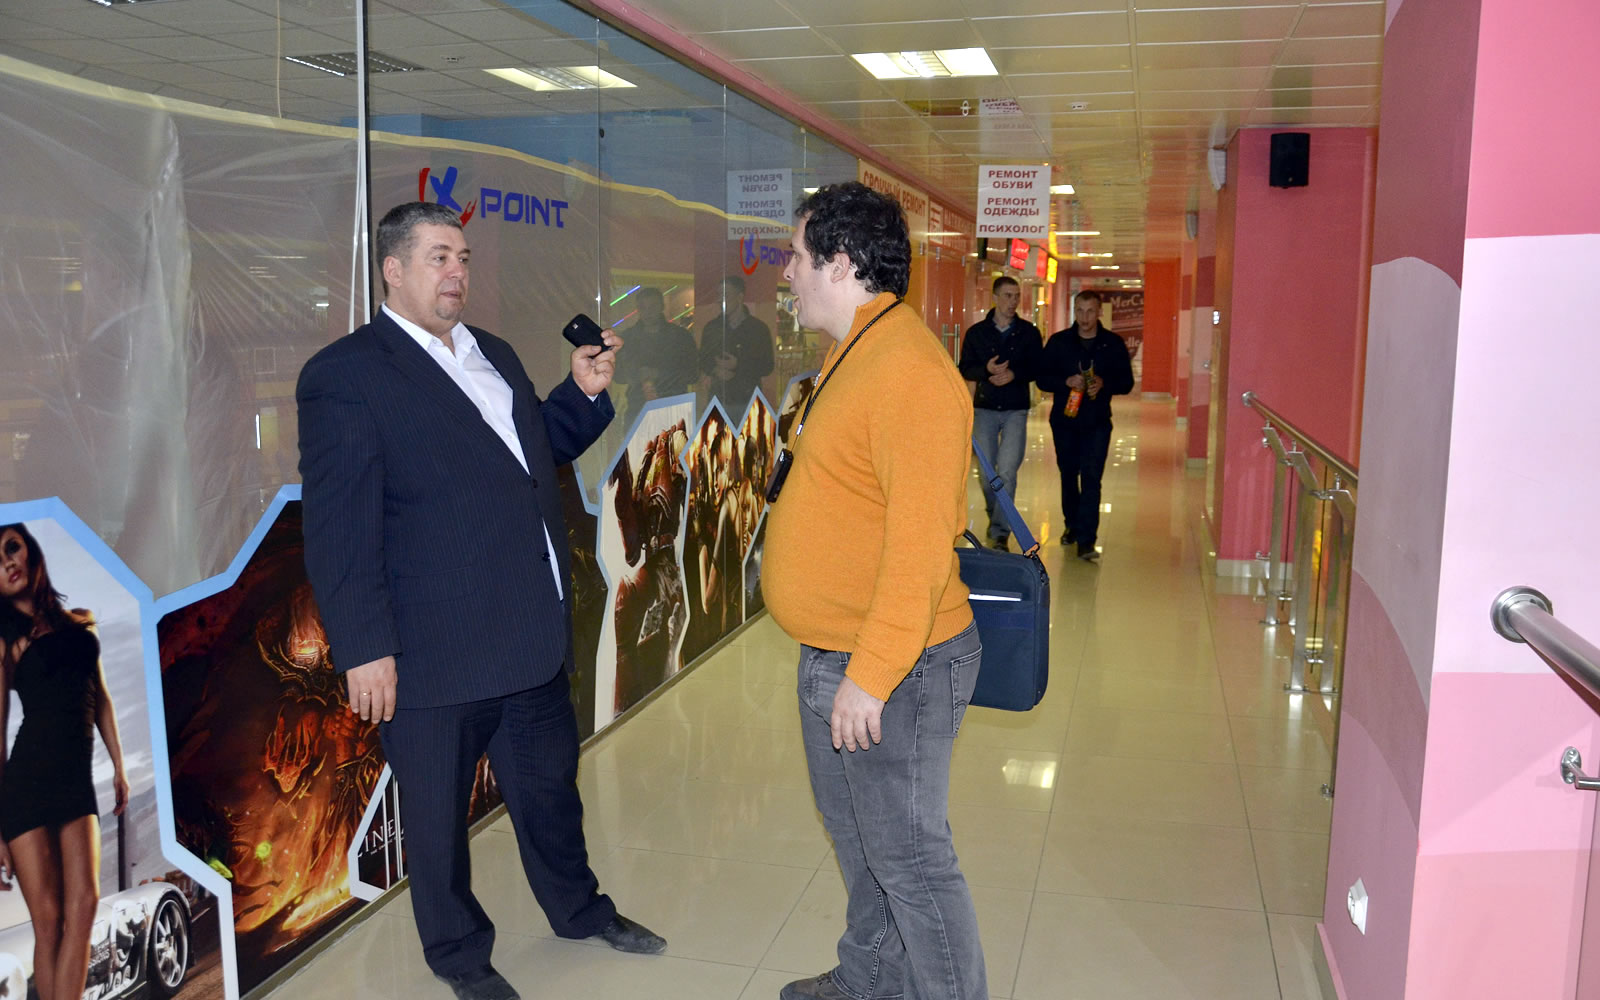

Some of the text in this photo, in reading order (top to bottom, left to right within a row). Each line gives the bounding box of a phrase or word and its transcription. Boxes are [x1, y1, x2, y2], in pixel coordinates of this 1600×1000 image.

[988, 170, 1038, 178] РЕМОНТ
[992, 181, 1033, 189] ОБУВИ
[903, 189, 926, 216] РЕМОНТ
[987, 197, 1037, 206] РЕМОНТ
[480, 187, 568, 228] POINT
[984, 207, 1040, 216] ОДЕЖДЫ
[979, 224, 1045, 234] ПСИХОЛОГ
[358, 818, 405, 858] INE
